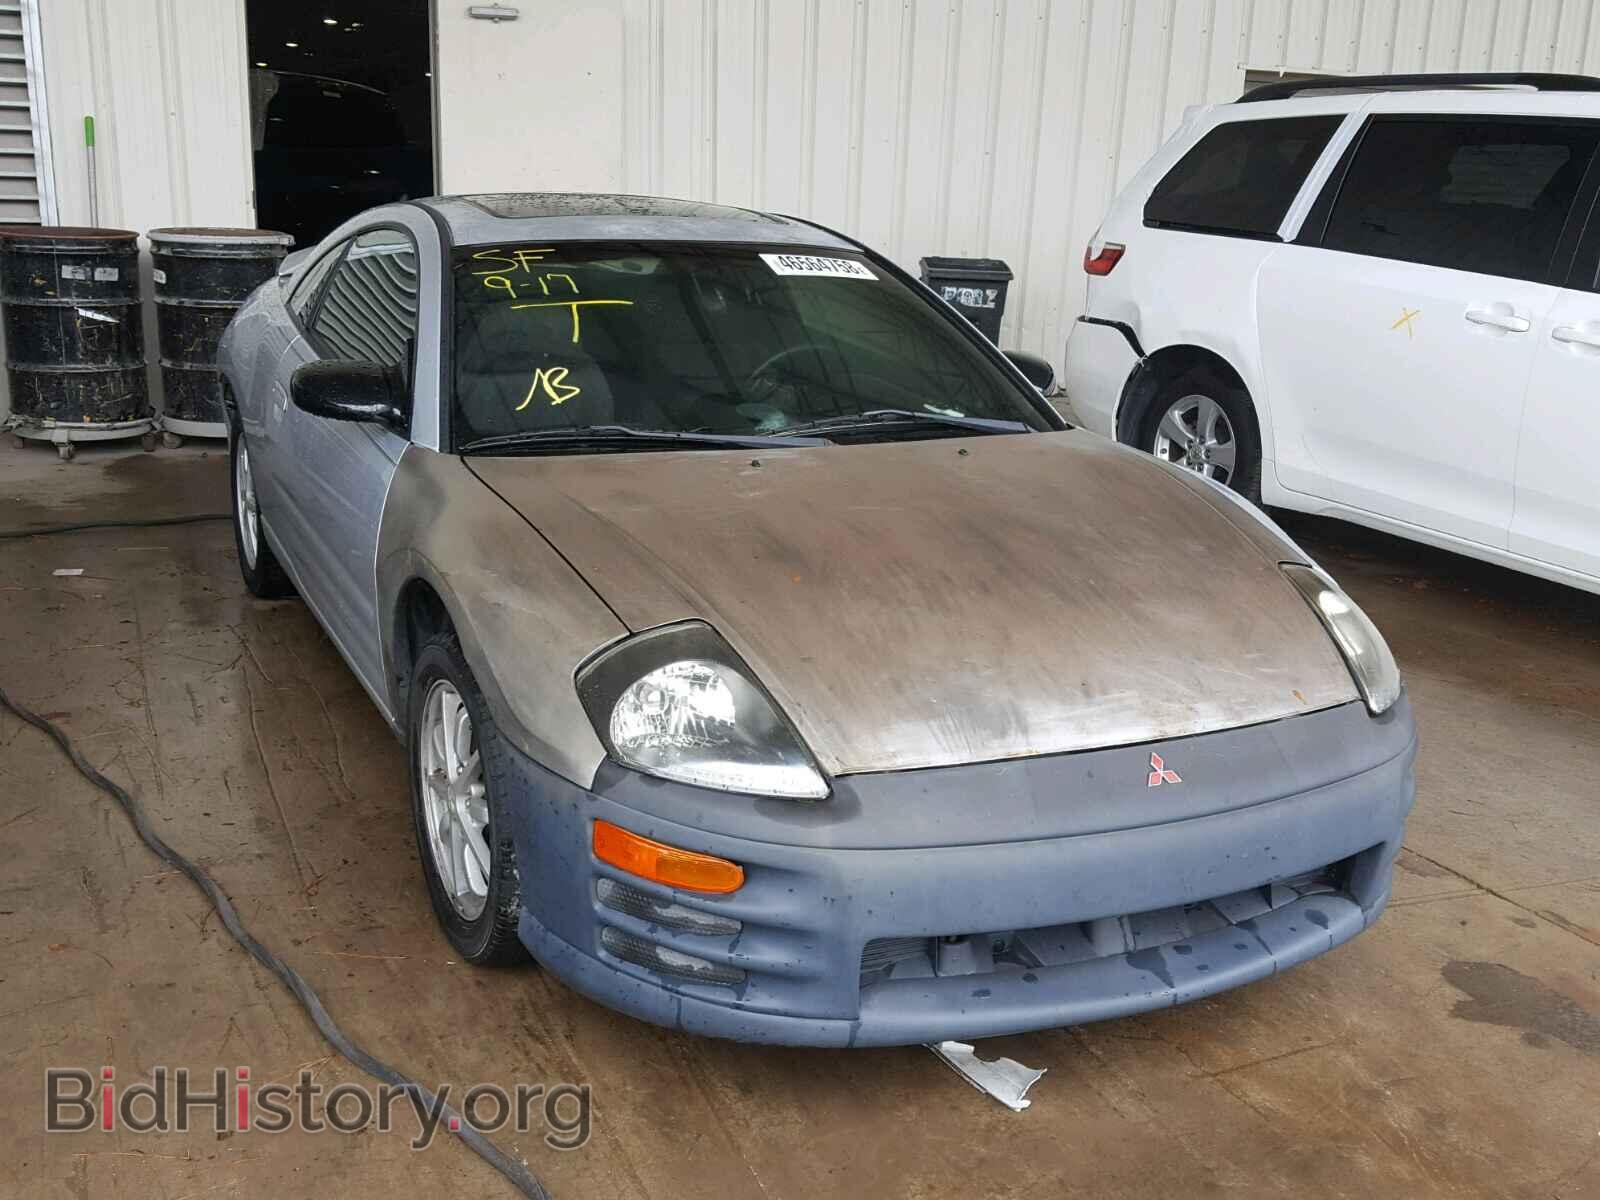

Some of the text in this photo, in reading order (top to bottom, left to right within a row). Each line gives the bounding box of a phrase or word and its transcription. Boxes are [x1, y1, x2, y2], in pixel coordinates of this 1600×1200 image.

[472, 248, 556, 275] SF
[777, 255, 860, 275] 46564758
[484, 273, 580, 298] 9-17
